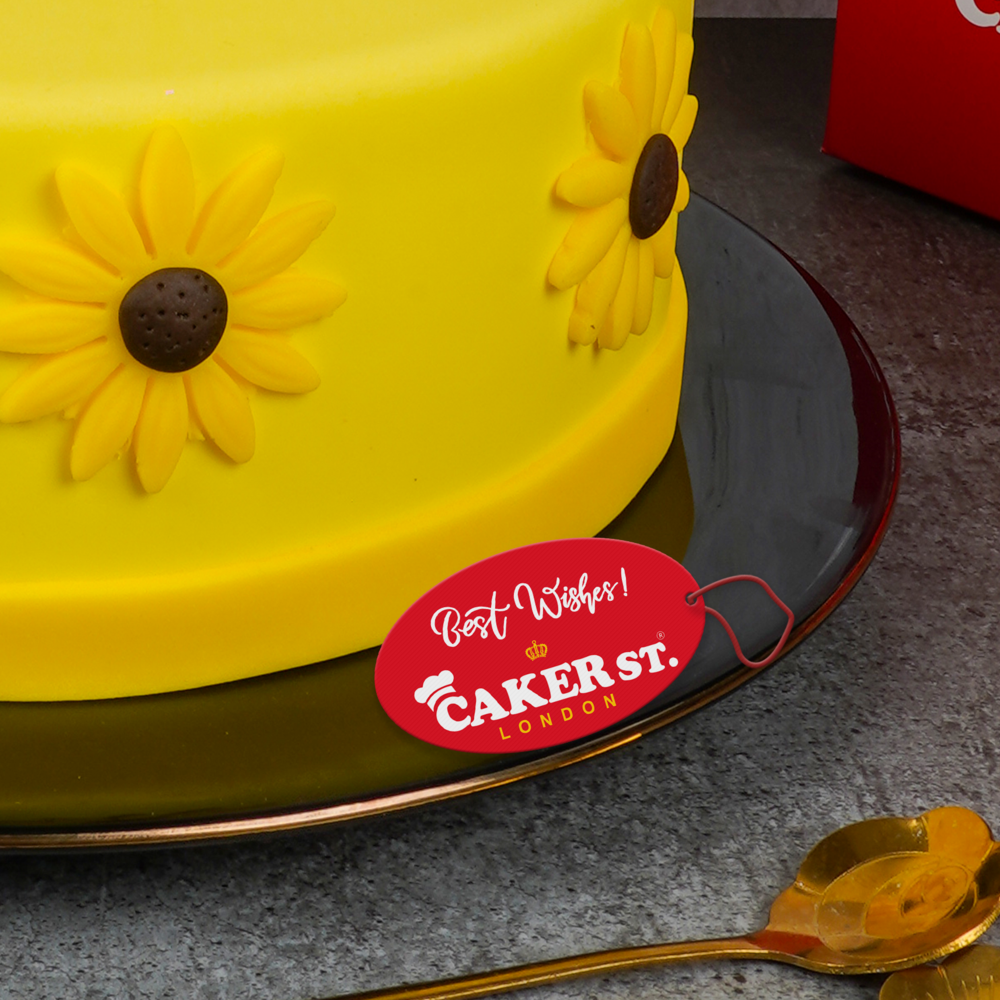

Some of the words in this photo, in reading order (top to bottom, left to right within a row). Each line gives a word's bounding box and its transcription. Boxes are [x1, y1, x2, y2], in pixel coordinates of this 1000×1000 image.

[430, 590, 511, 648] Best
[513, 566, 629, 621] Wishes!
[436, 654, 616, 733] CAKER
[498, 693, 618, 741] LONDON
